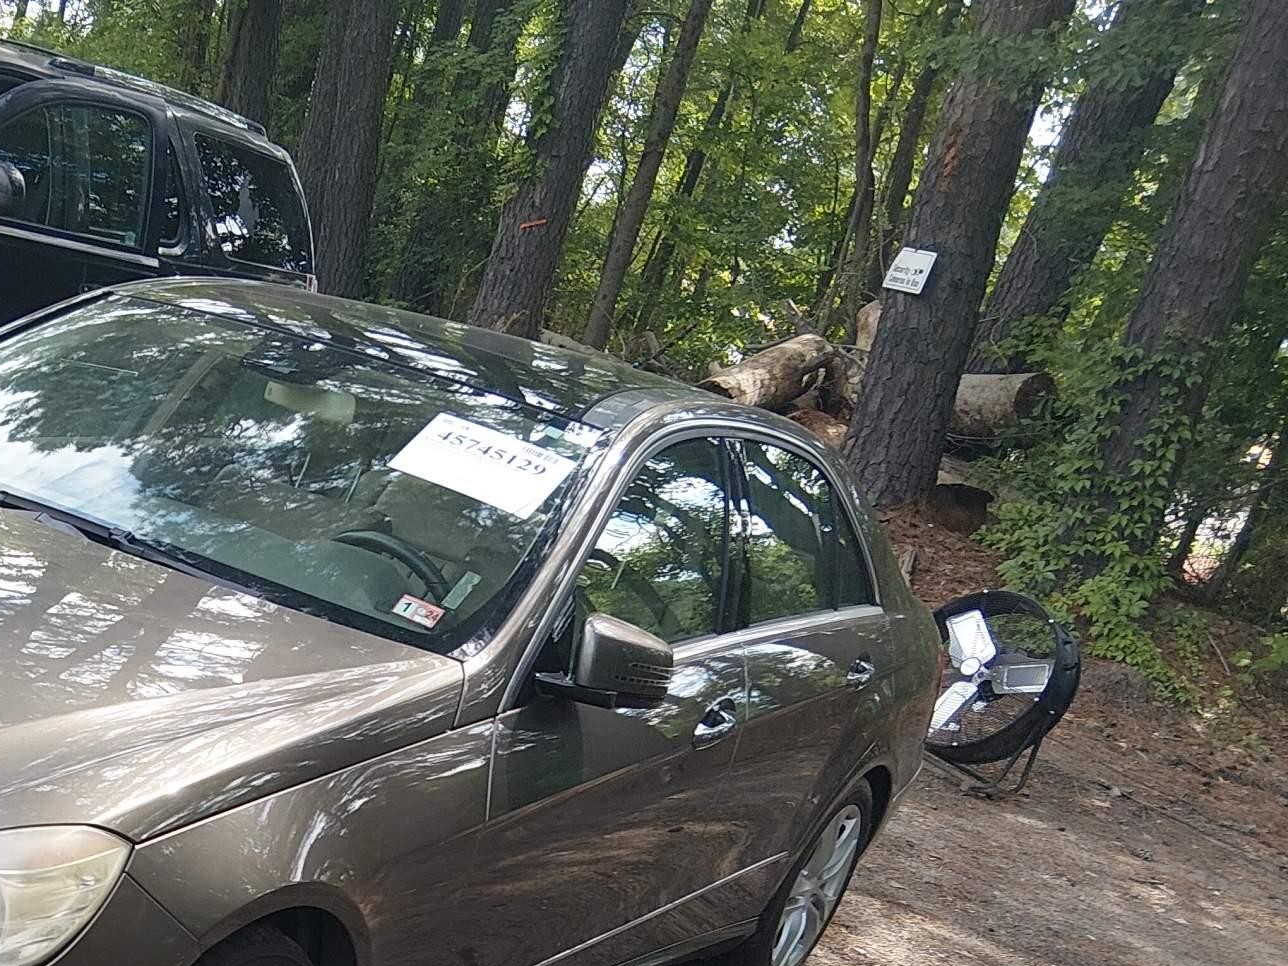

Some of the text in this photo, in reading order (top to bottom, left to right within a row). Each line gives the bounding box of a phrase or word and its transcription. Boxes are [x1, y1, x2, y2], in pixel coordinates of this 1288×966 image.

[437, 430, 548, 476] 45745129
[402, 602, 413, 612] 1
[425, 610, 440, 622] 24
